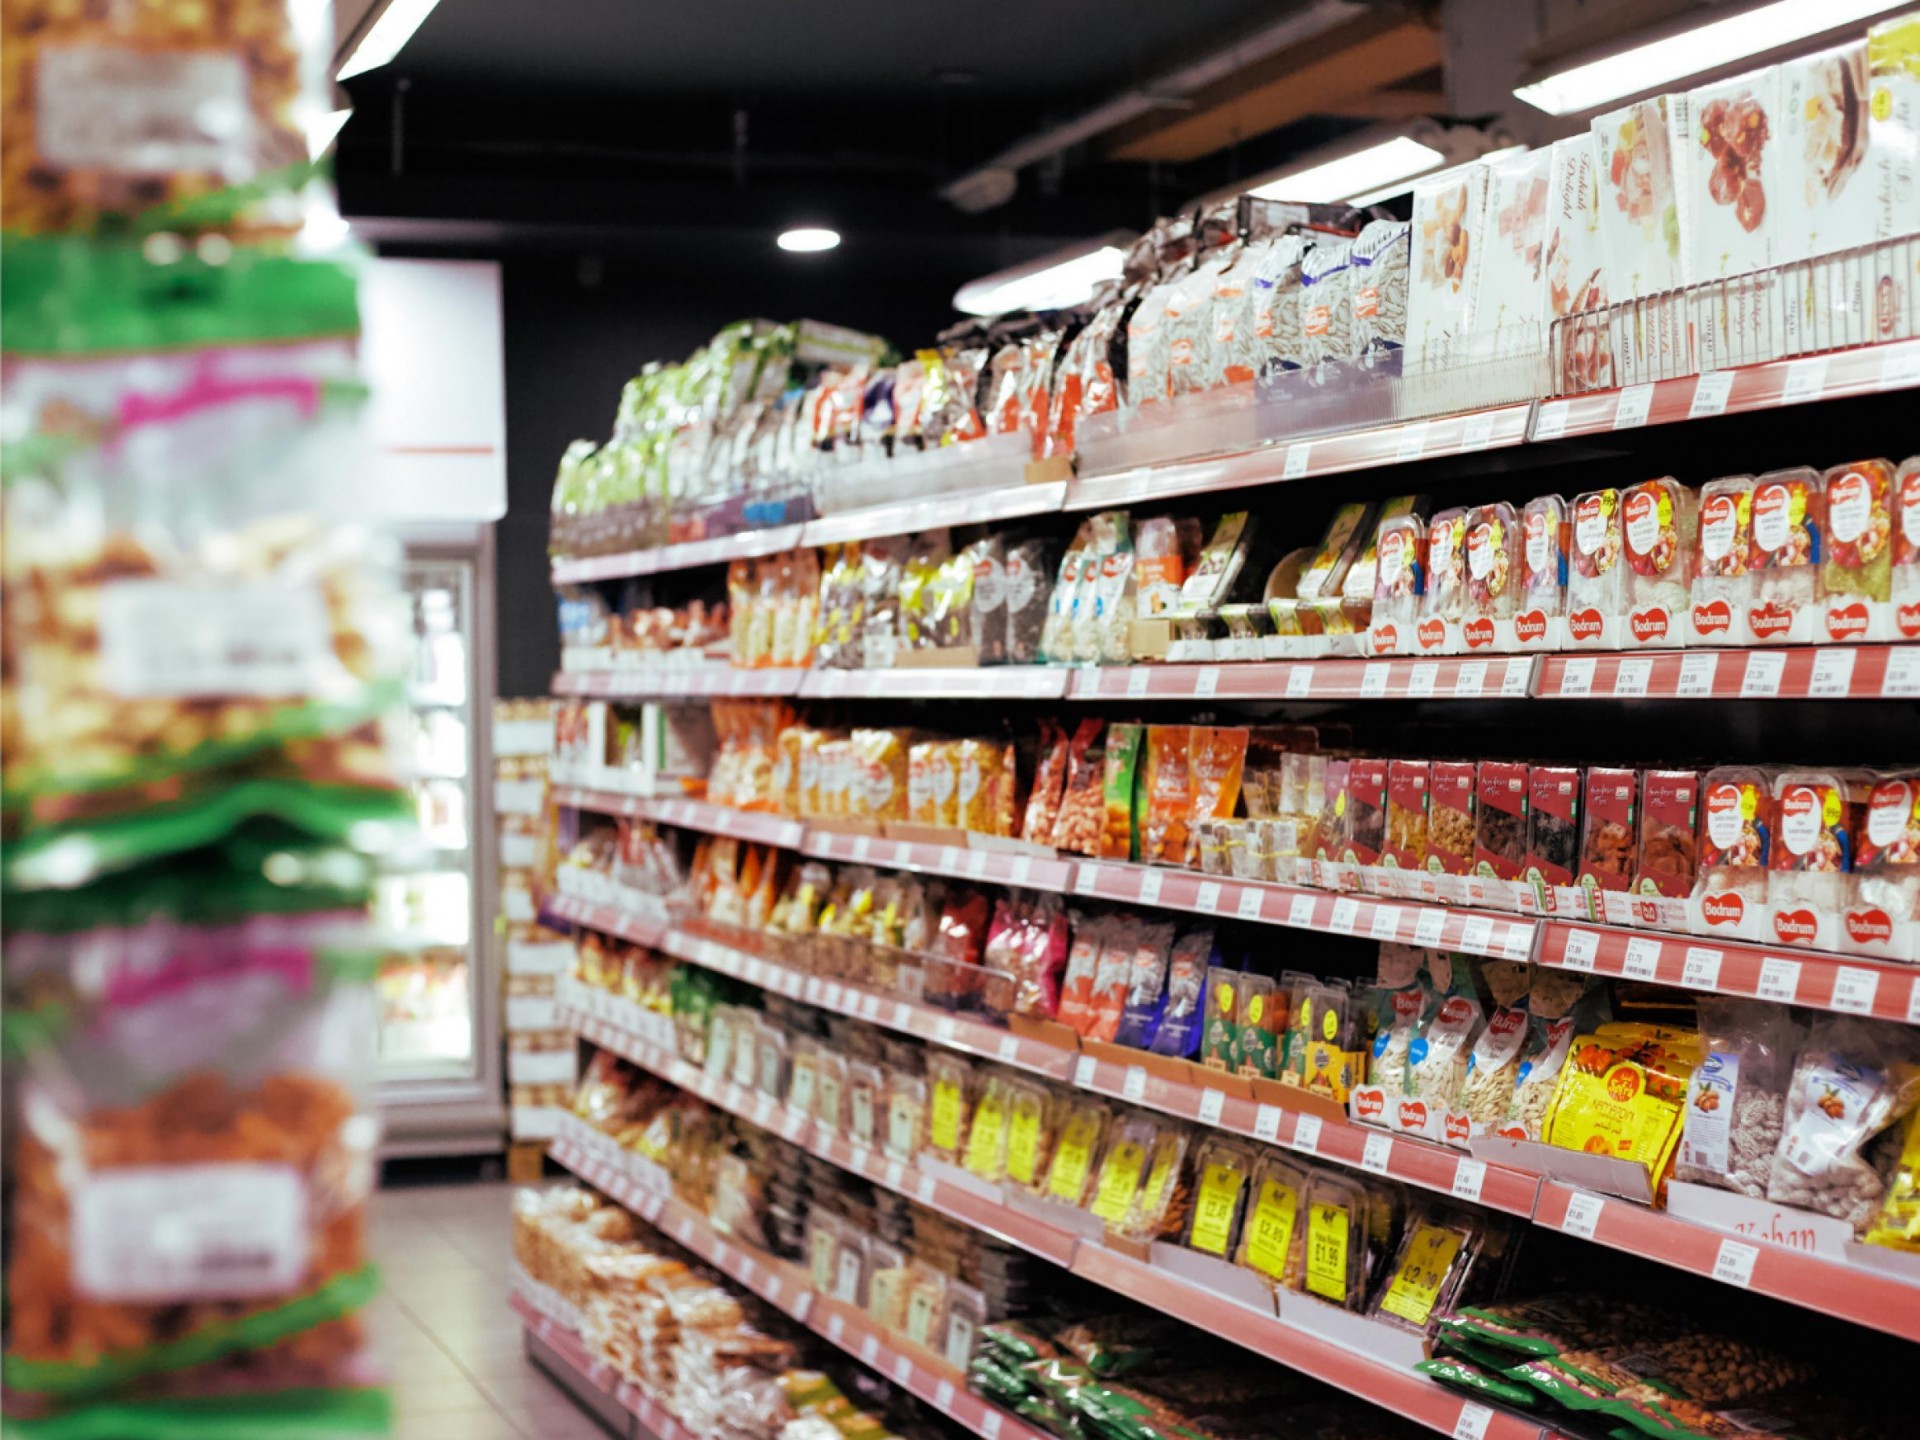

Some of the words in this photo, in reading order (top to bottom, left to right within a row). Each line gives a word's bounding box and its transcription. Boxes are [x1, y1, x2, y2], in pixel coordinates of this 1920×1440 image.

[1517, 619, 1544, 634] Bodrum
[1571, 618, 1600, 633] Bodrum
[1634, 619, 1665, 634] Bodrum
[1695, 612, 1728, 626] Bodrum
[1752, 615, 1789, 629] Bodrum
[1829, 615, 1866, 630] Bodrum
[1466, 627, 1493, 641] Bodrum
[1705, 902, 1740, 917] Bodrum
[1777, 918, 1815, 934] Bodrum
[1850, 918, 1889, 935] Bodrum
